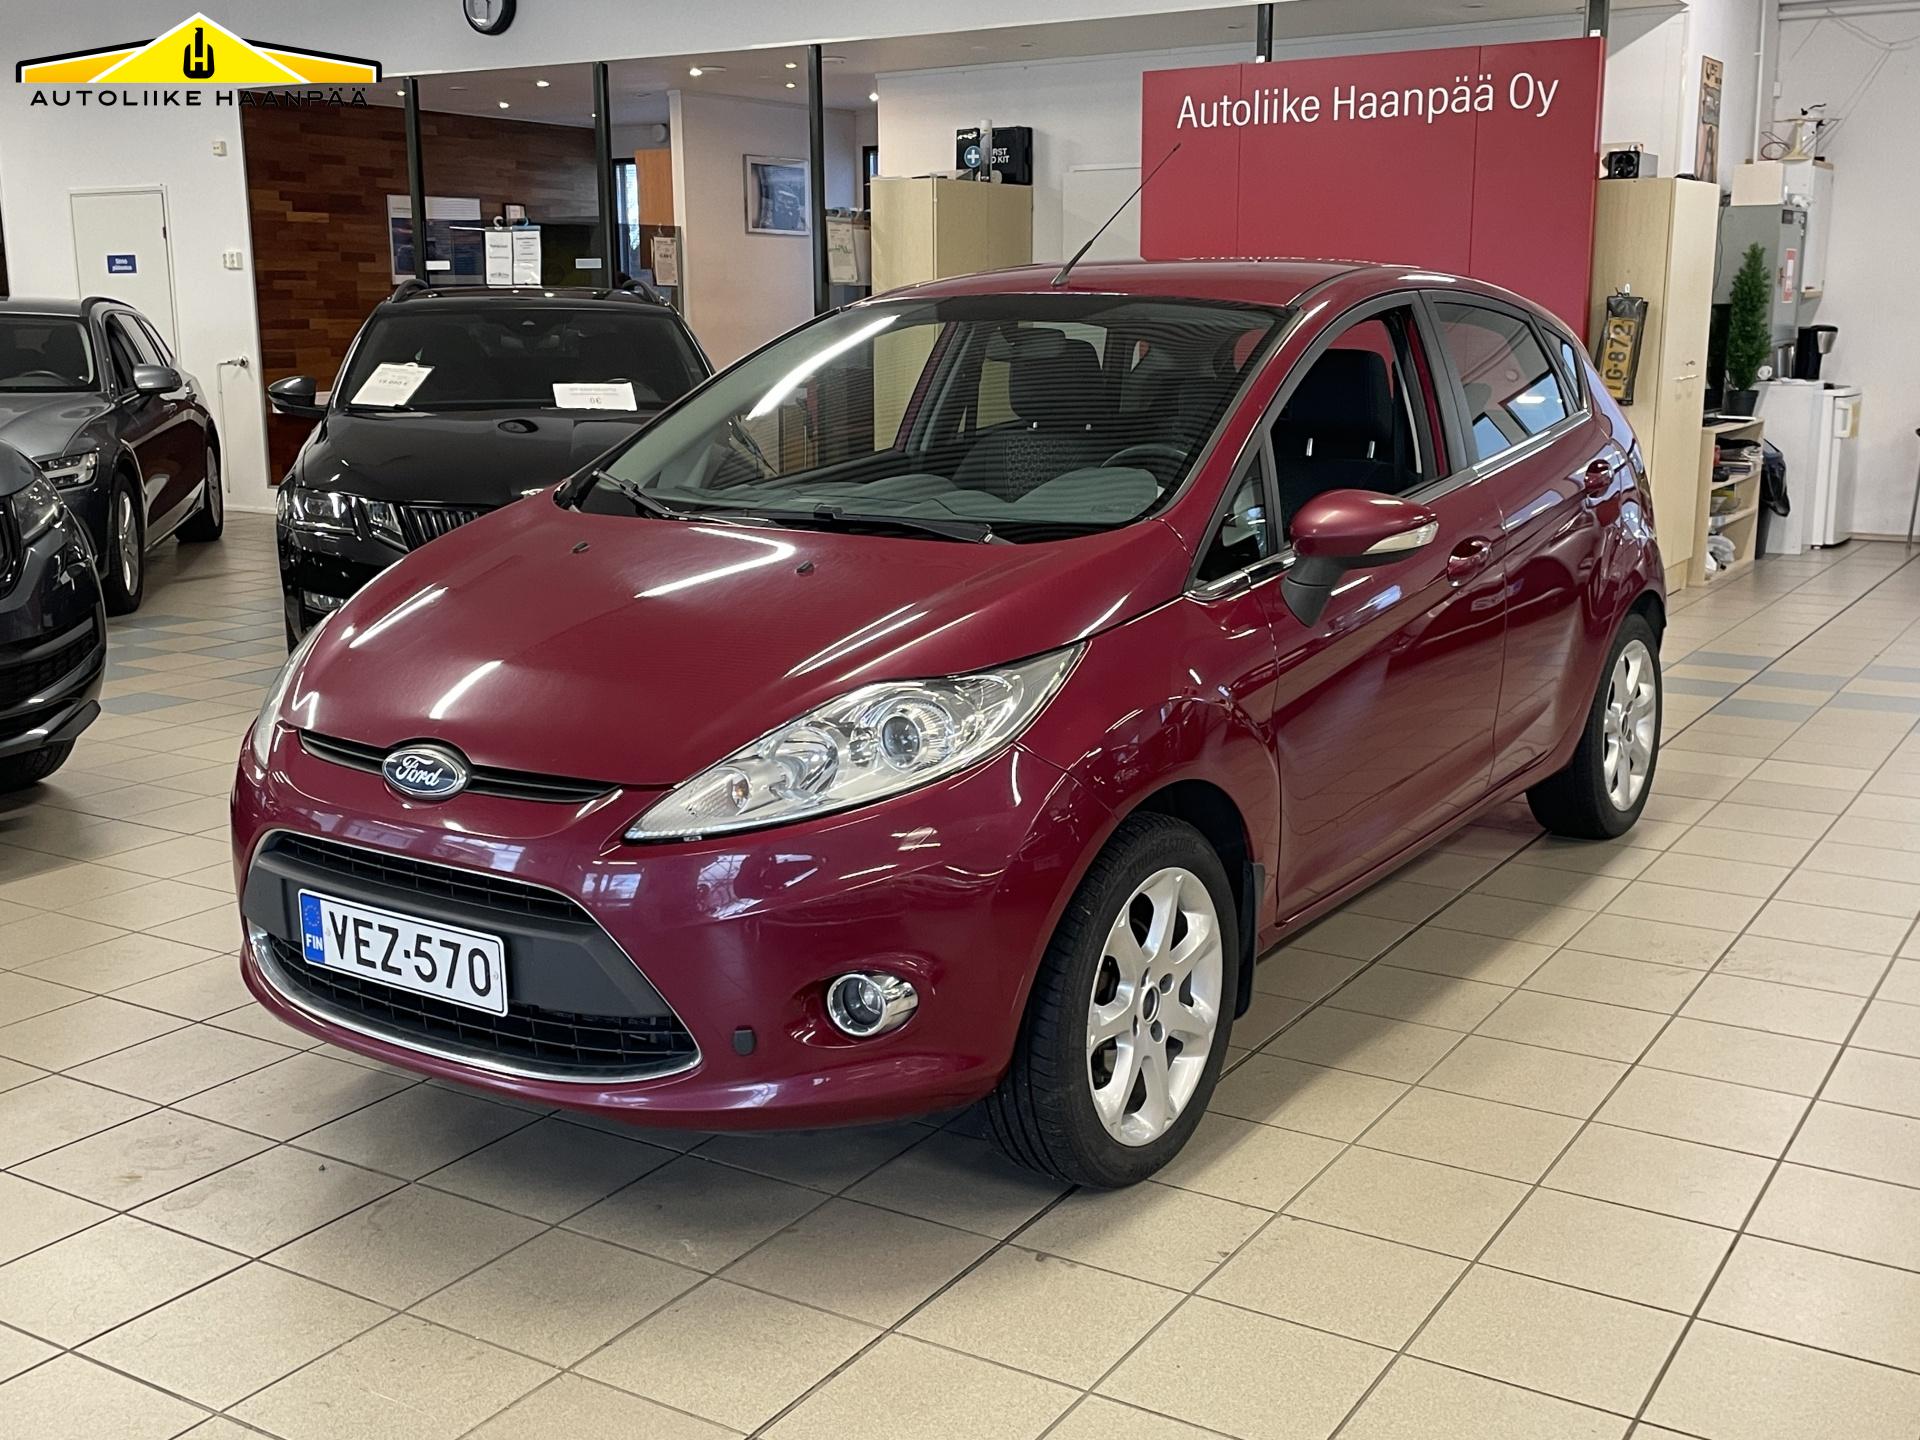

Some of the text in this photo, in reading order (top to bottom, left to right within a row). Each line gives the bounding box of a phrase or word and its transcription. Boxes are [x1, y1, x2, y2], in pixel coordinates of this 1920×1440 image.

[1176, 71, 1560, 130] Autoliike Haanpää Oy
[997, 154, 1010, 164] KIT
[394, 755, 444, 787] Ford
[305, 933, 324, 952] FIN
